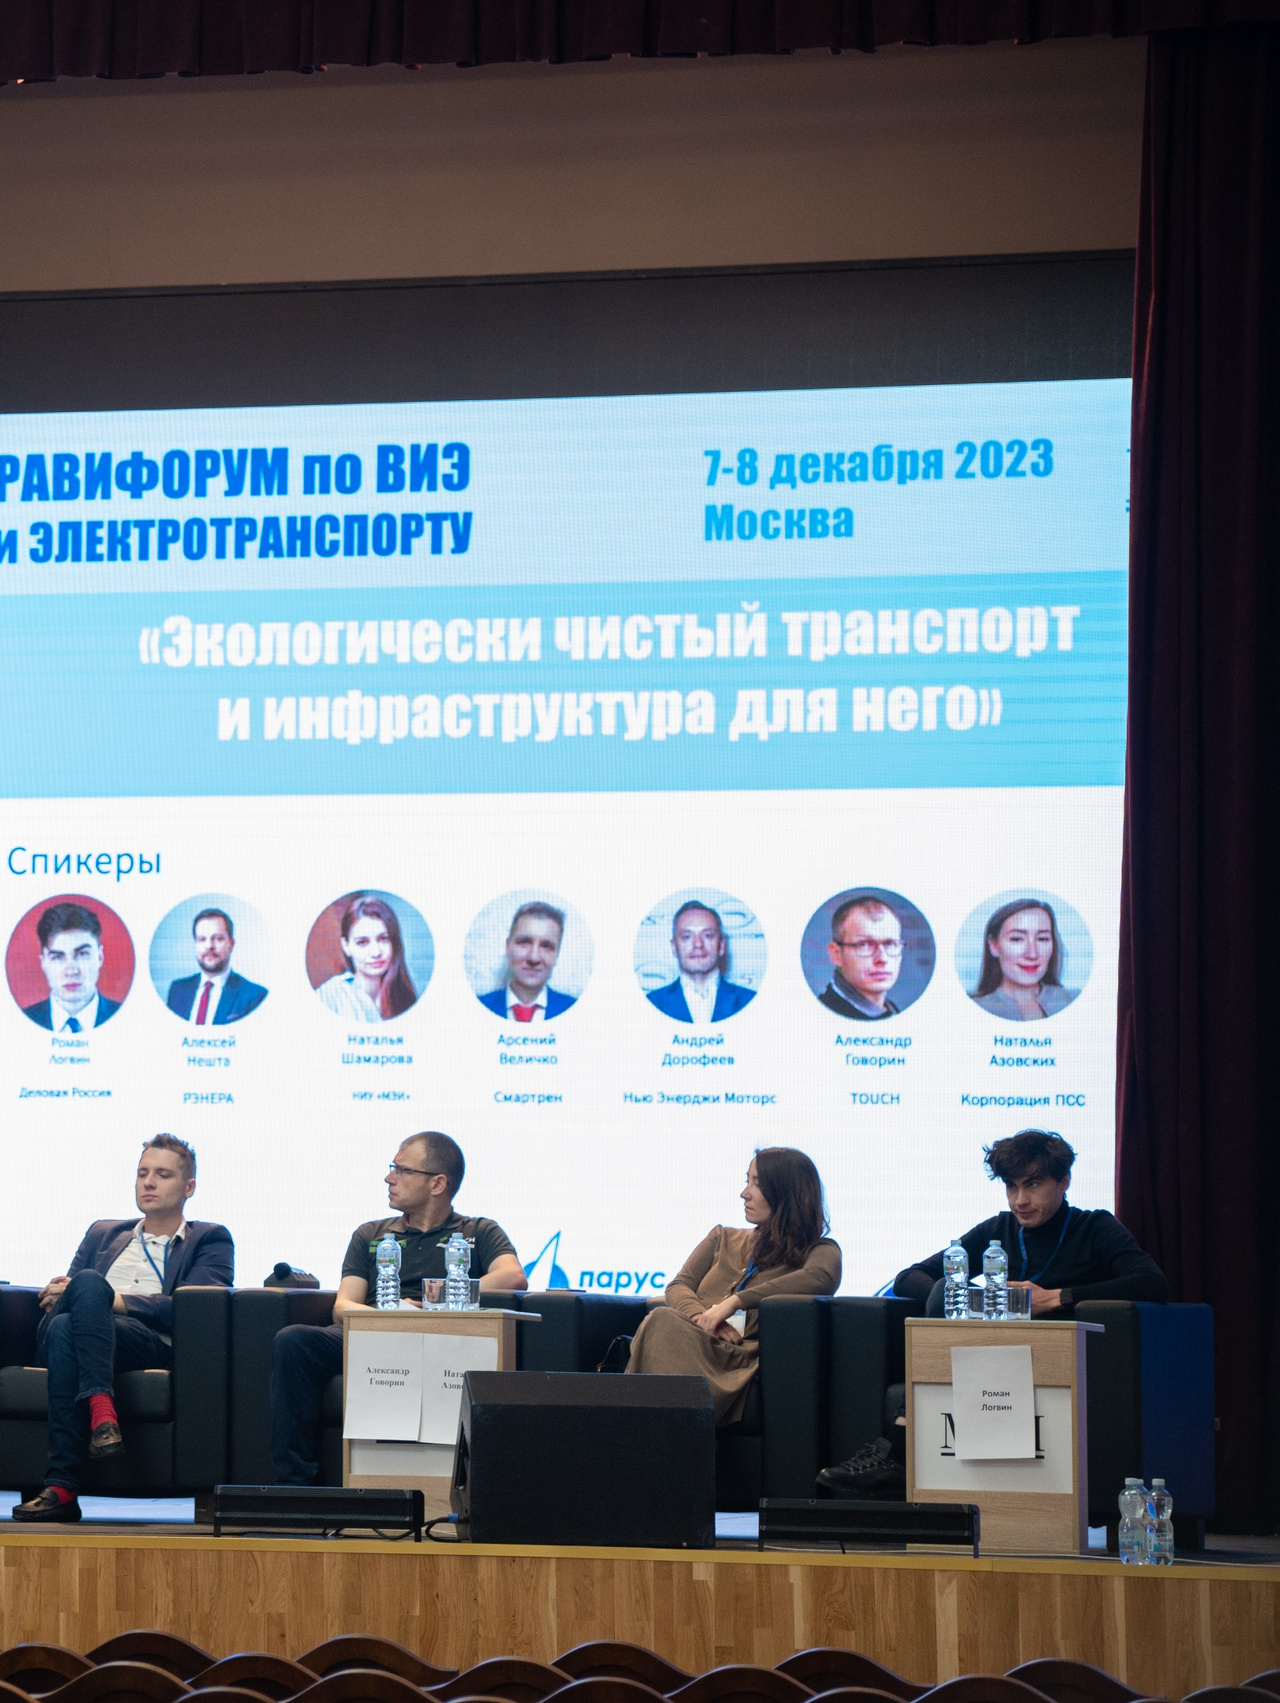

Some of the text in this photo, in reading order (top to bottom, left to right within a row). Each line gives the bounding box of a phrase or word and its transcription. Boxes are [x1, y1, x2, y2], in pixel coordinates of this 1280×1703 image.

[703, 437, 1054, 489] 7-8 декабря 2023
[302, 452, 361, 497] по
[376, 443, 472, 493] ВИЭ
[703, 505, 854, 542] Москва
[28, 511, 474, 562] ЭЛЕКТРОТРАНСПОРТУ
[139, 601, 1081, 668] «Экологически чистый транспорт
[217, 684, 1003, 745] и инфраструктура для него»
[7, 845, 163, 881] Спикеры
[182, 1036, 236, 1047] Алексей
[348, 1035, 403, 1045] Наталья
[497, 1034, 556, 1046] Арсений
[672, 1034, 724, 1047] Андрей
[835, 1035, 912, 1048] Александр
[994, 1035, 1052, 1046] Наталья
[187, 1056, 230, 1067] Нешта
[342, 1053, 413, 1066] Шамарова
[500, 1053, 558, 1065] Величко
[662, 1054, 735, 1067] Дорофеев
[846, 1054, 905, 1068] Говорин
[990, 1055, 1055, 1067] Азовских
[183, 1093, 234, 1104] РЭНЕРА
[495, 1091, 562, 1104] Смартрен
[624, 1092, 776, 1106] Нью Энерджи Моторс
[962, 1094, 1085, 1108] Корпорация ПСС
[579, 1268, 667, 1293] парус
[366, 1367, 410, 1376] Александр
[444, 1370, 464, 1378] Ната
[370, 1378, 404, 1388] Говорин
